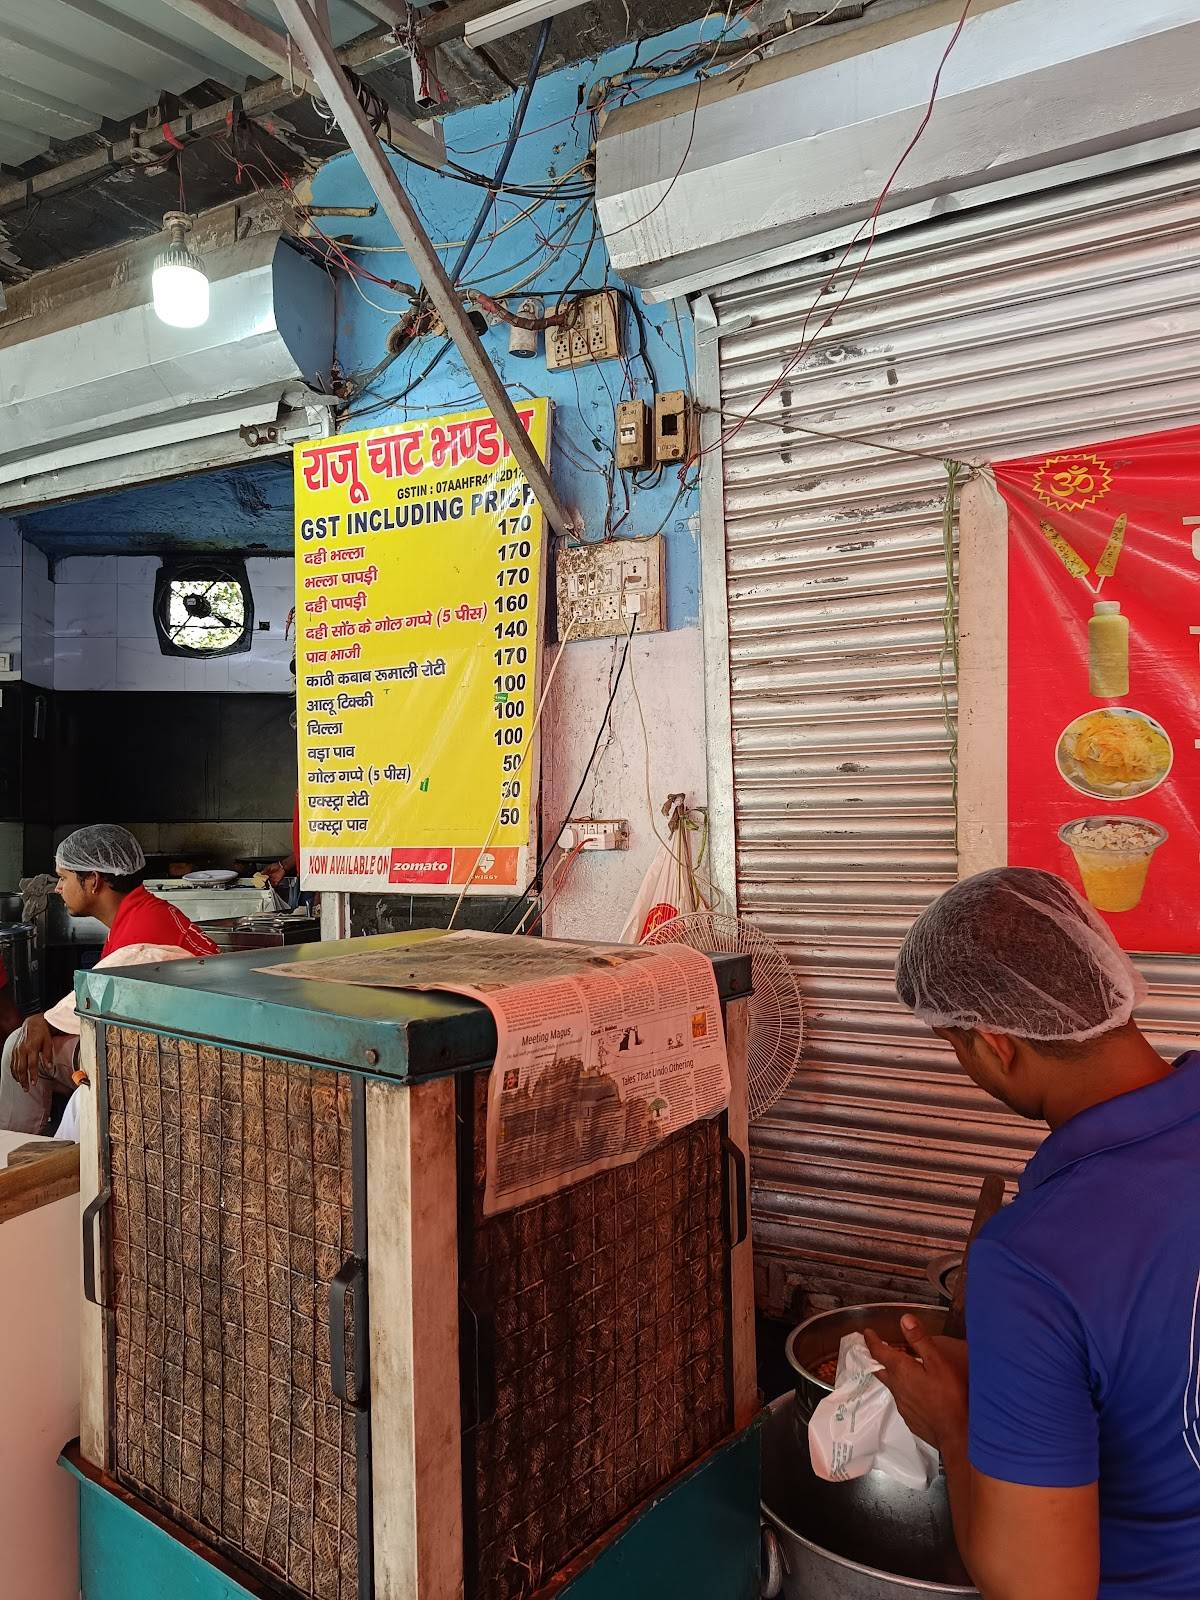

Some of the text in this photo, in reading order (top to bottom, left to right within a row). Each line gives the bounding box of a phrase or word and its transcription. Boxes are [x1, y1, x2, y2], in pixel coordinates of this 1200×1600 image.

[302, 442, 369, 502] राजू
[368, 430, 424, 478] चाट
[397, 484, 427, 499] GSTIN
[301, 516, 340, 540] GST
[347, 497, 463, 534] INCLUDING
[304, 515, 531, 564] दही भल्ला 170
[305, 541, 530, 588] भल्ला पापड़ी 170
[305, 568, 529, 613] दही पापड़ी 170
[305, 593, 528, 640] दही सोंठ के गोल गप्पे (5 पीस) 160
[306, 620, 527, 663] पाव भाजी 140
[306, 647, 526, 687] काठी कबाब रूमाली रोटी 170
[307, 674, 526, 715] आलू टिक्की 100
[307, 700, 524, 735] चिल्ला 100
[307, 727, 522, 762] वड़ा पाव 100
[308, 754, 521, 785] गोल गप्पे (5 पीस) 50
[308, 795, 344, 811] एक्स्ट्रा
[347, 790, 370, 806] रोटी
[308, 808, 519, 835] एक्स्ट्रा पाव 50
[309, 855, 390, 875] NOW AVAILABLE ON
[393, 861, 448, 871] zomato
[521, 1032, 549, 1046] Meeting
[622, 1059, 694, 1086] Tales That Undo Othering
